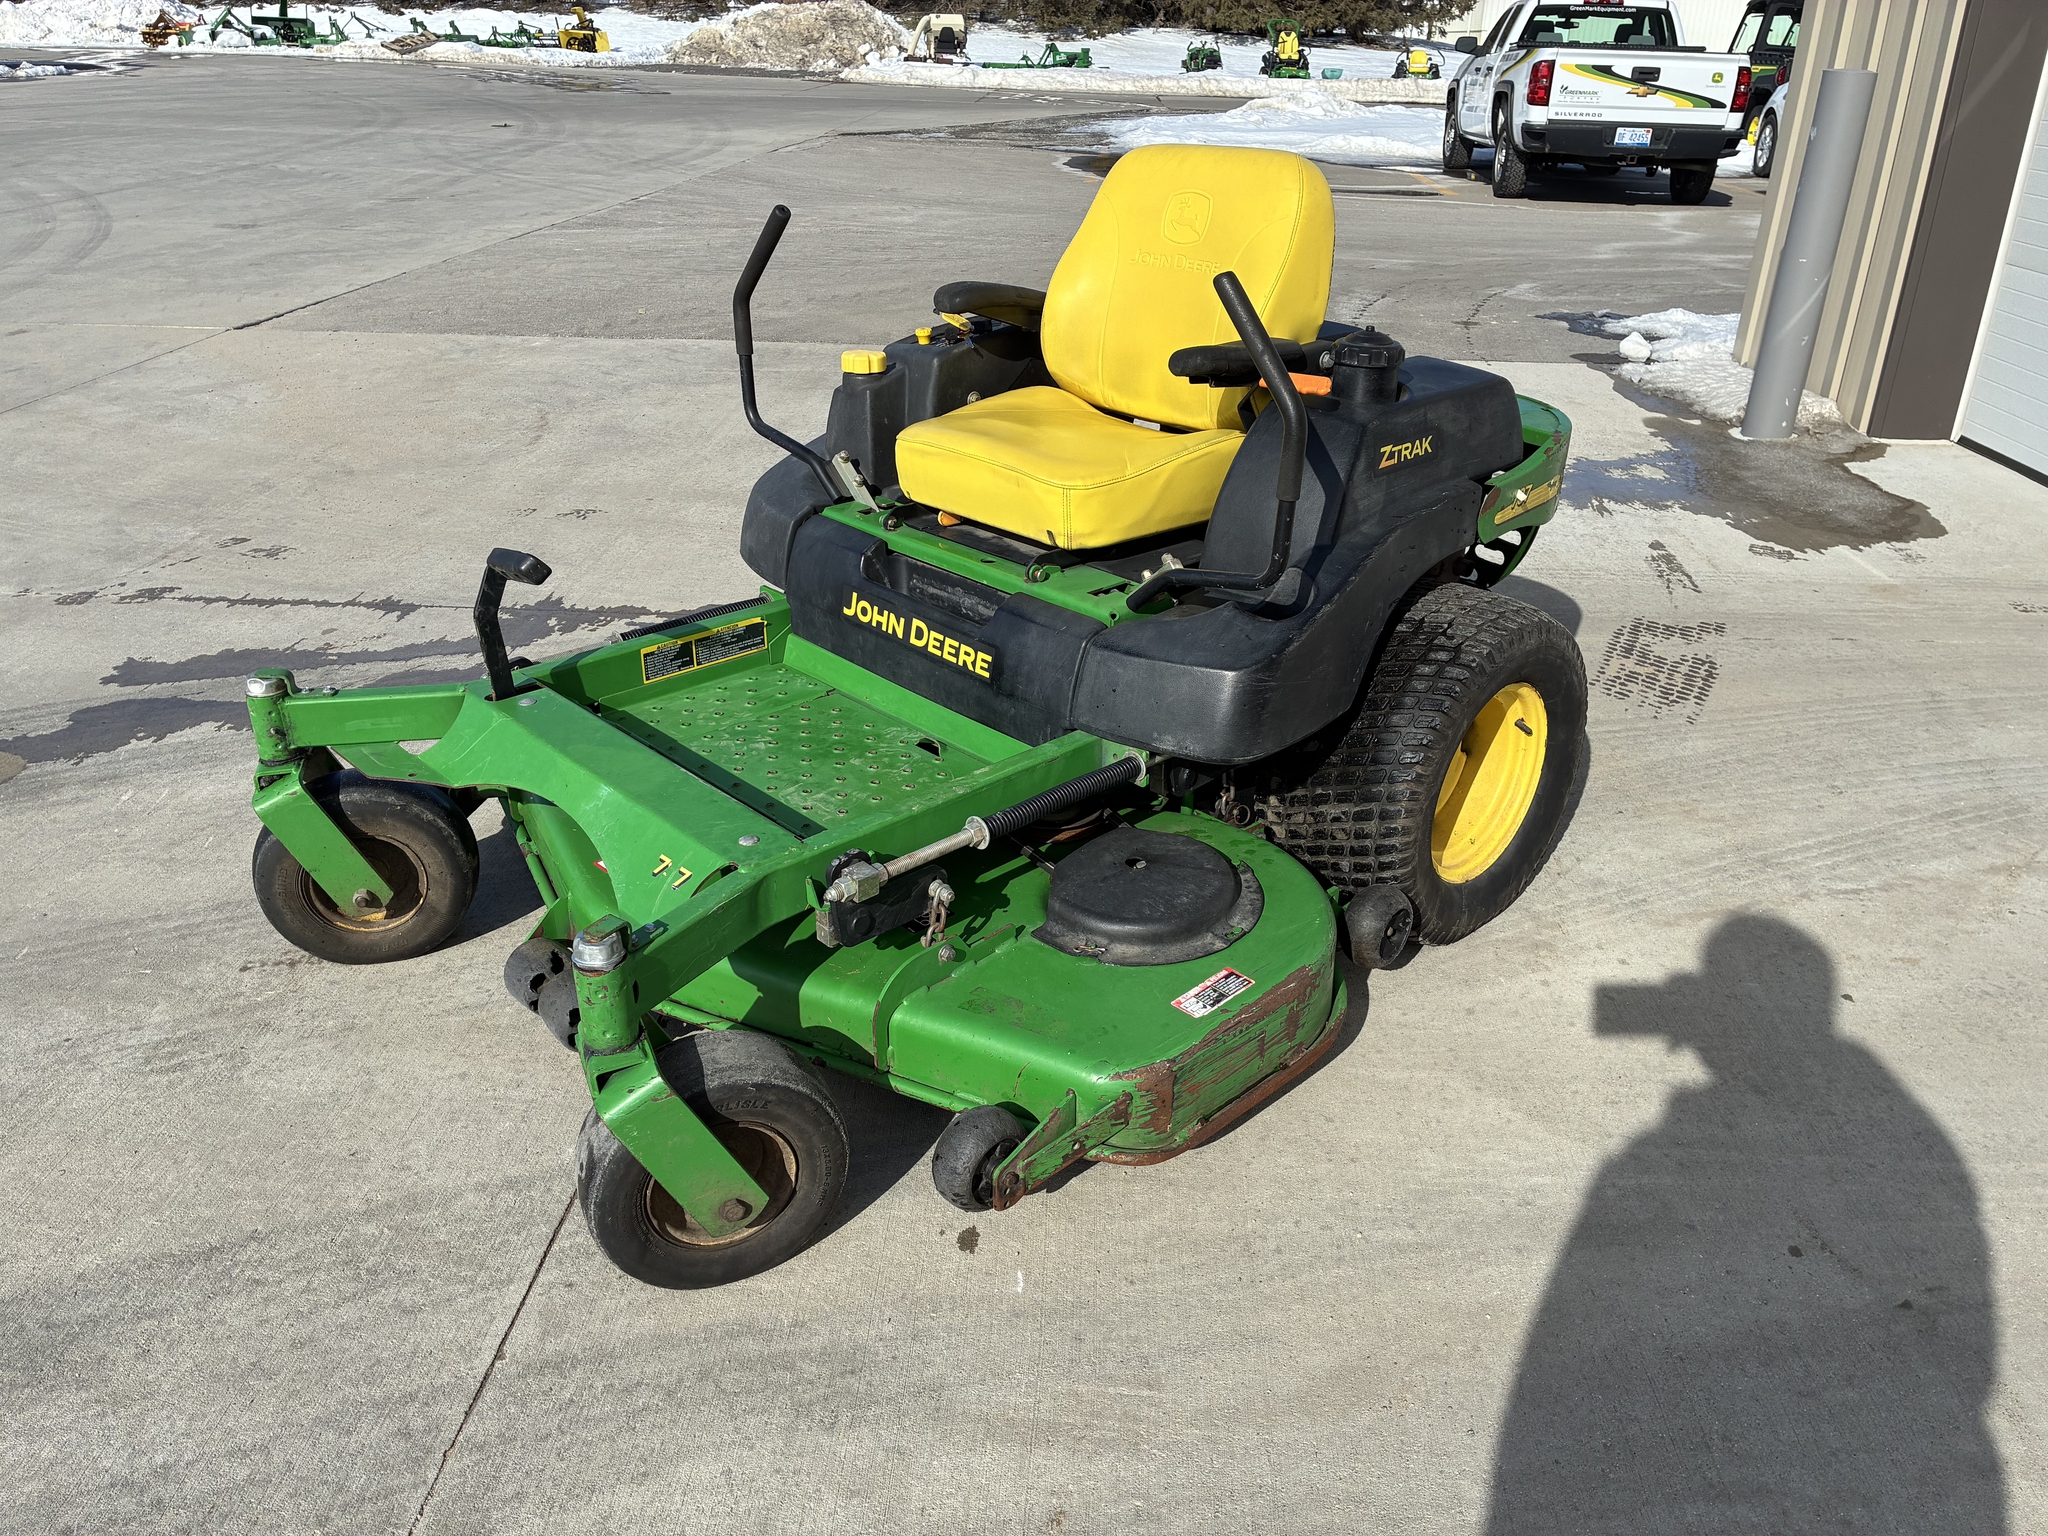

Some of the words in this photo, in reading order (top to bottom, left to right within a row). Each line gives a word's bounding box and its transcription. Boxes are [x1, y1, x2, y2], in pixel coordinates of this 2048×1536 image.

[1570, 5, 1637, 13] GreenMarkEquipment.com
[1128, 248, 1173, 269] JOHN
[1174, 252, 1222, 276] DEERE
[1378, 435, 1434, 470] ZTRAK
[843, 591, 905, 640] JOHN
[909, 617, 993, 679] DEERE
[715, 1099, 773, 1113] RLISLE
